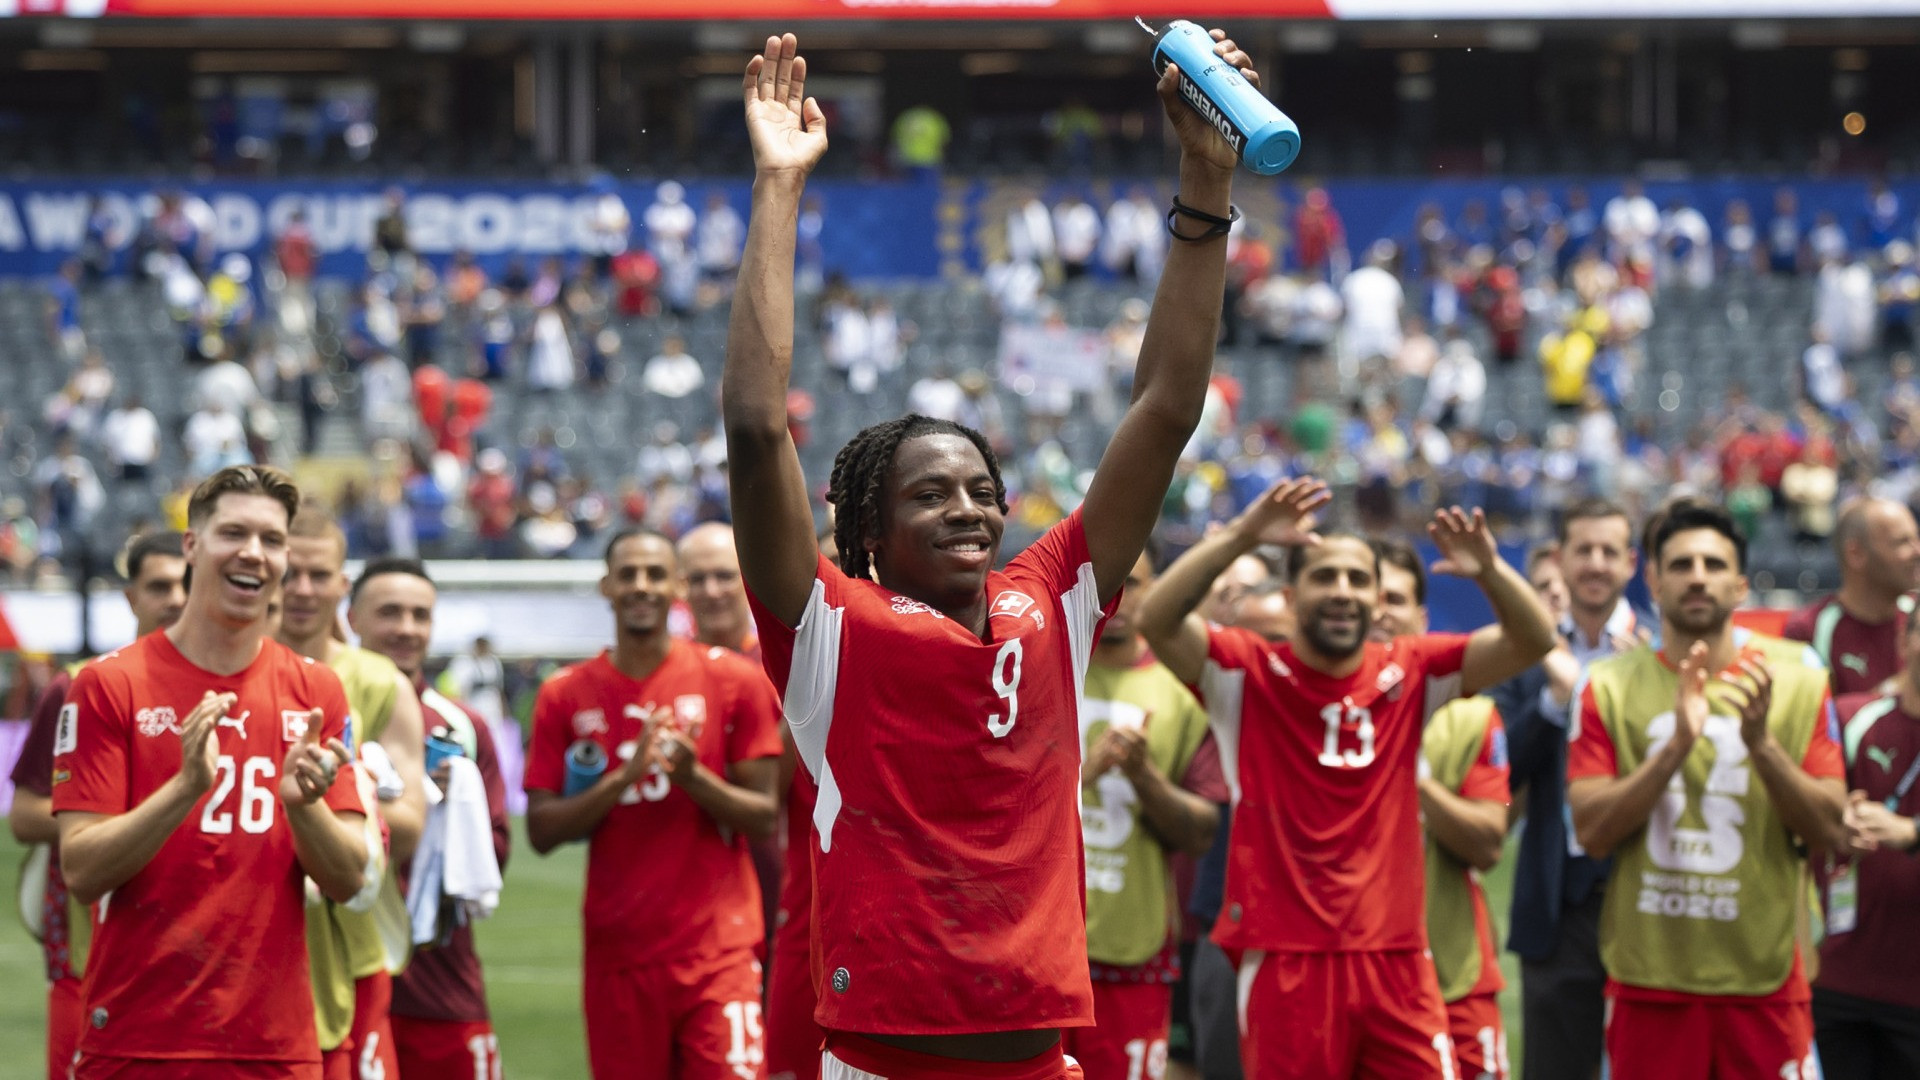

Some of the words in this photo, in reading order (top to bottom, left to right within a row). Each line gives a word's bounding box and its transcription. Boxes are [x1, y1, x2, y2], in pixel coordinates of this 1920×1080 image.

[987, 637, 1023, 738] 9
[1318, 702, 1376, 768] 13
[200, 755, 275, 834] 26
[1638, 889, 1739, 922] 2026
